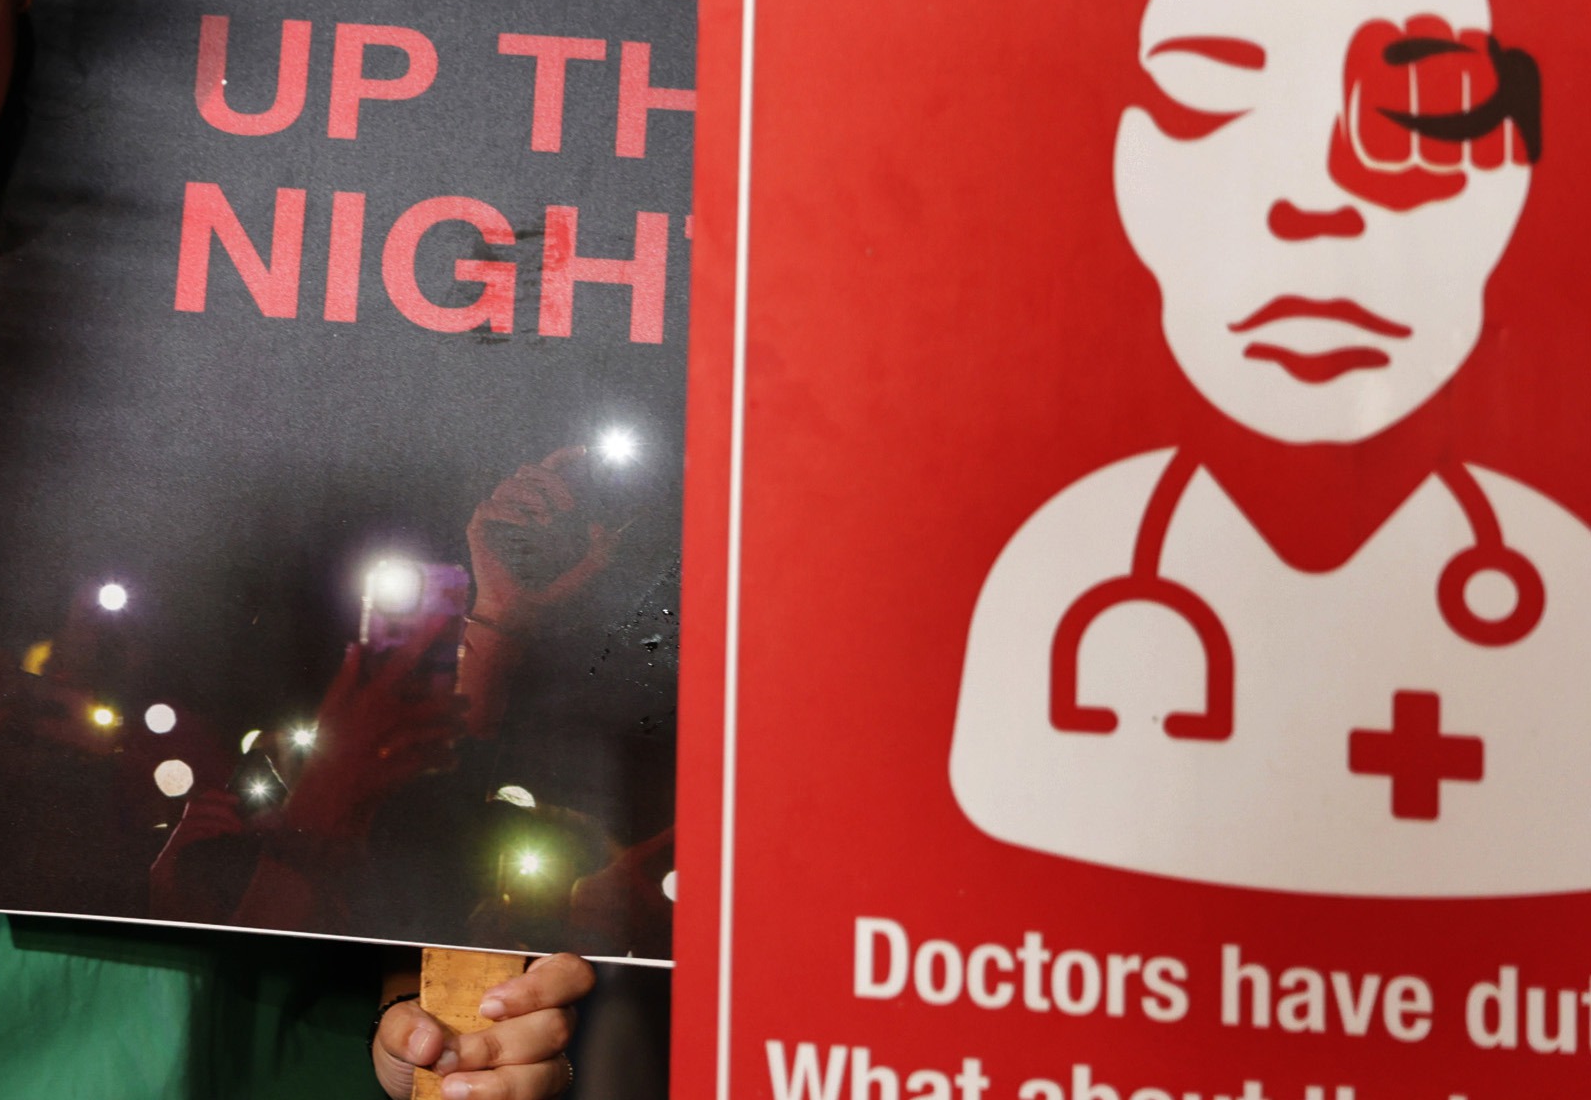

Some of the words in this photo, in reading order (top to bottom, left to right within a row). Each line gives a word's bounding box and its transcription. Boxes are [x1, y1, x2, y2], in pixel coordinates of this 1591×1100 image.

[195, 15, 439, 140] UP
[174, 181, 694, 345] NIGH
[853, 916, 1189, 1021] Doctors
[1222, 945, 1433, 1042] have
[1466, 966, 1591, 1054] du
